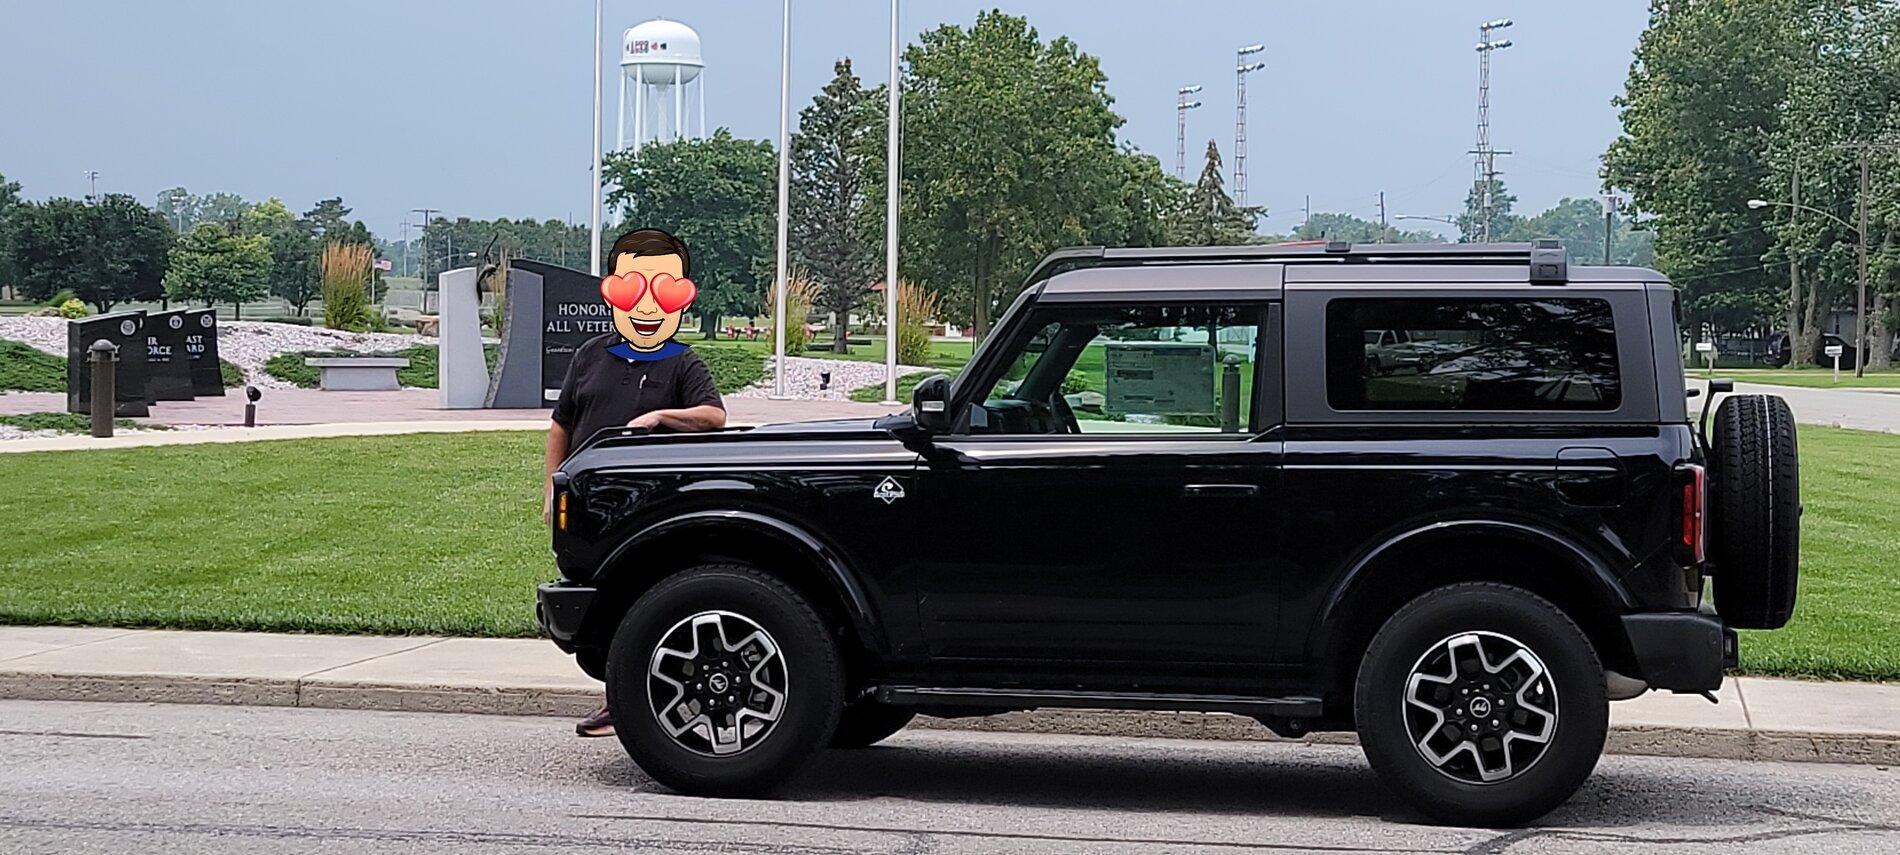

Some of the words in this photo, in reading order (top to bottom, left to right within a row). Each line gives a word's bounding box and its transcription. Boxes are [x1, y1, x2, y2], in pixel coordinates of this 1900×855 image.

[546, 321, 571, 333] ALL
[577, 321, 616, 333] VETER
[148, 336, 158, 346] IR
[186, 335, 203, 344] AST
[147, 346, 172, 356] ORCE
[186, 344, 205, 353] ARD
